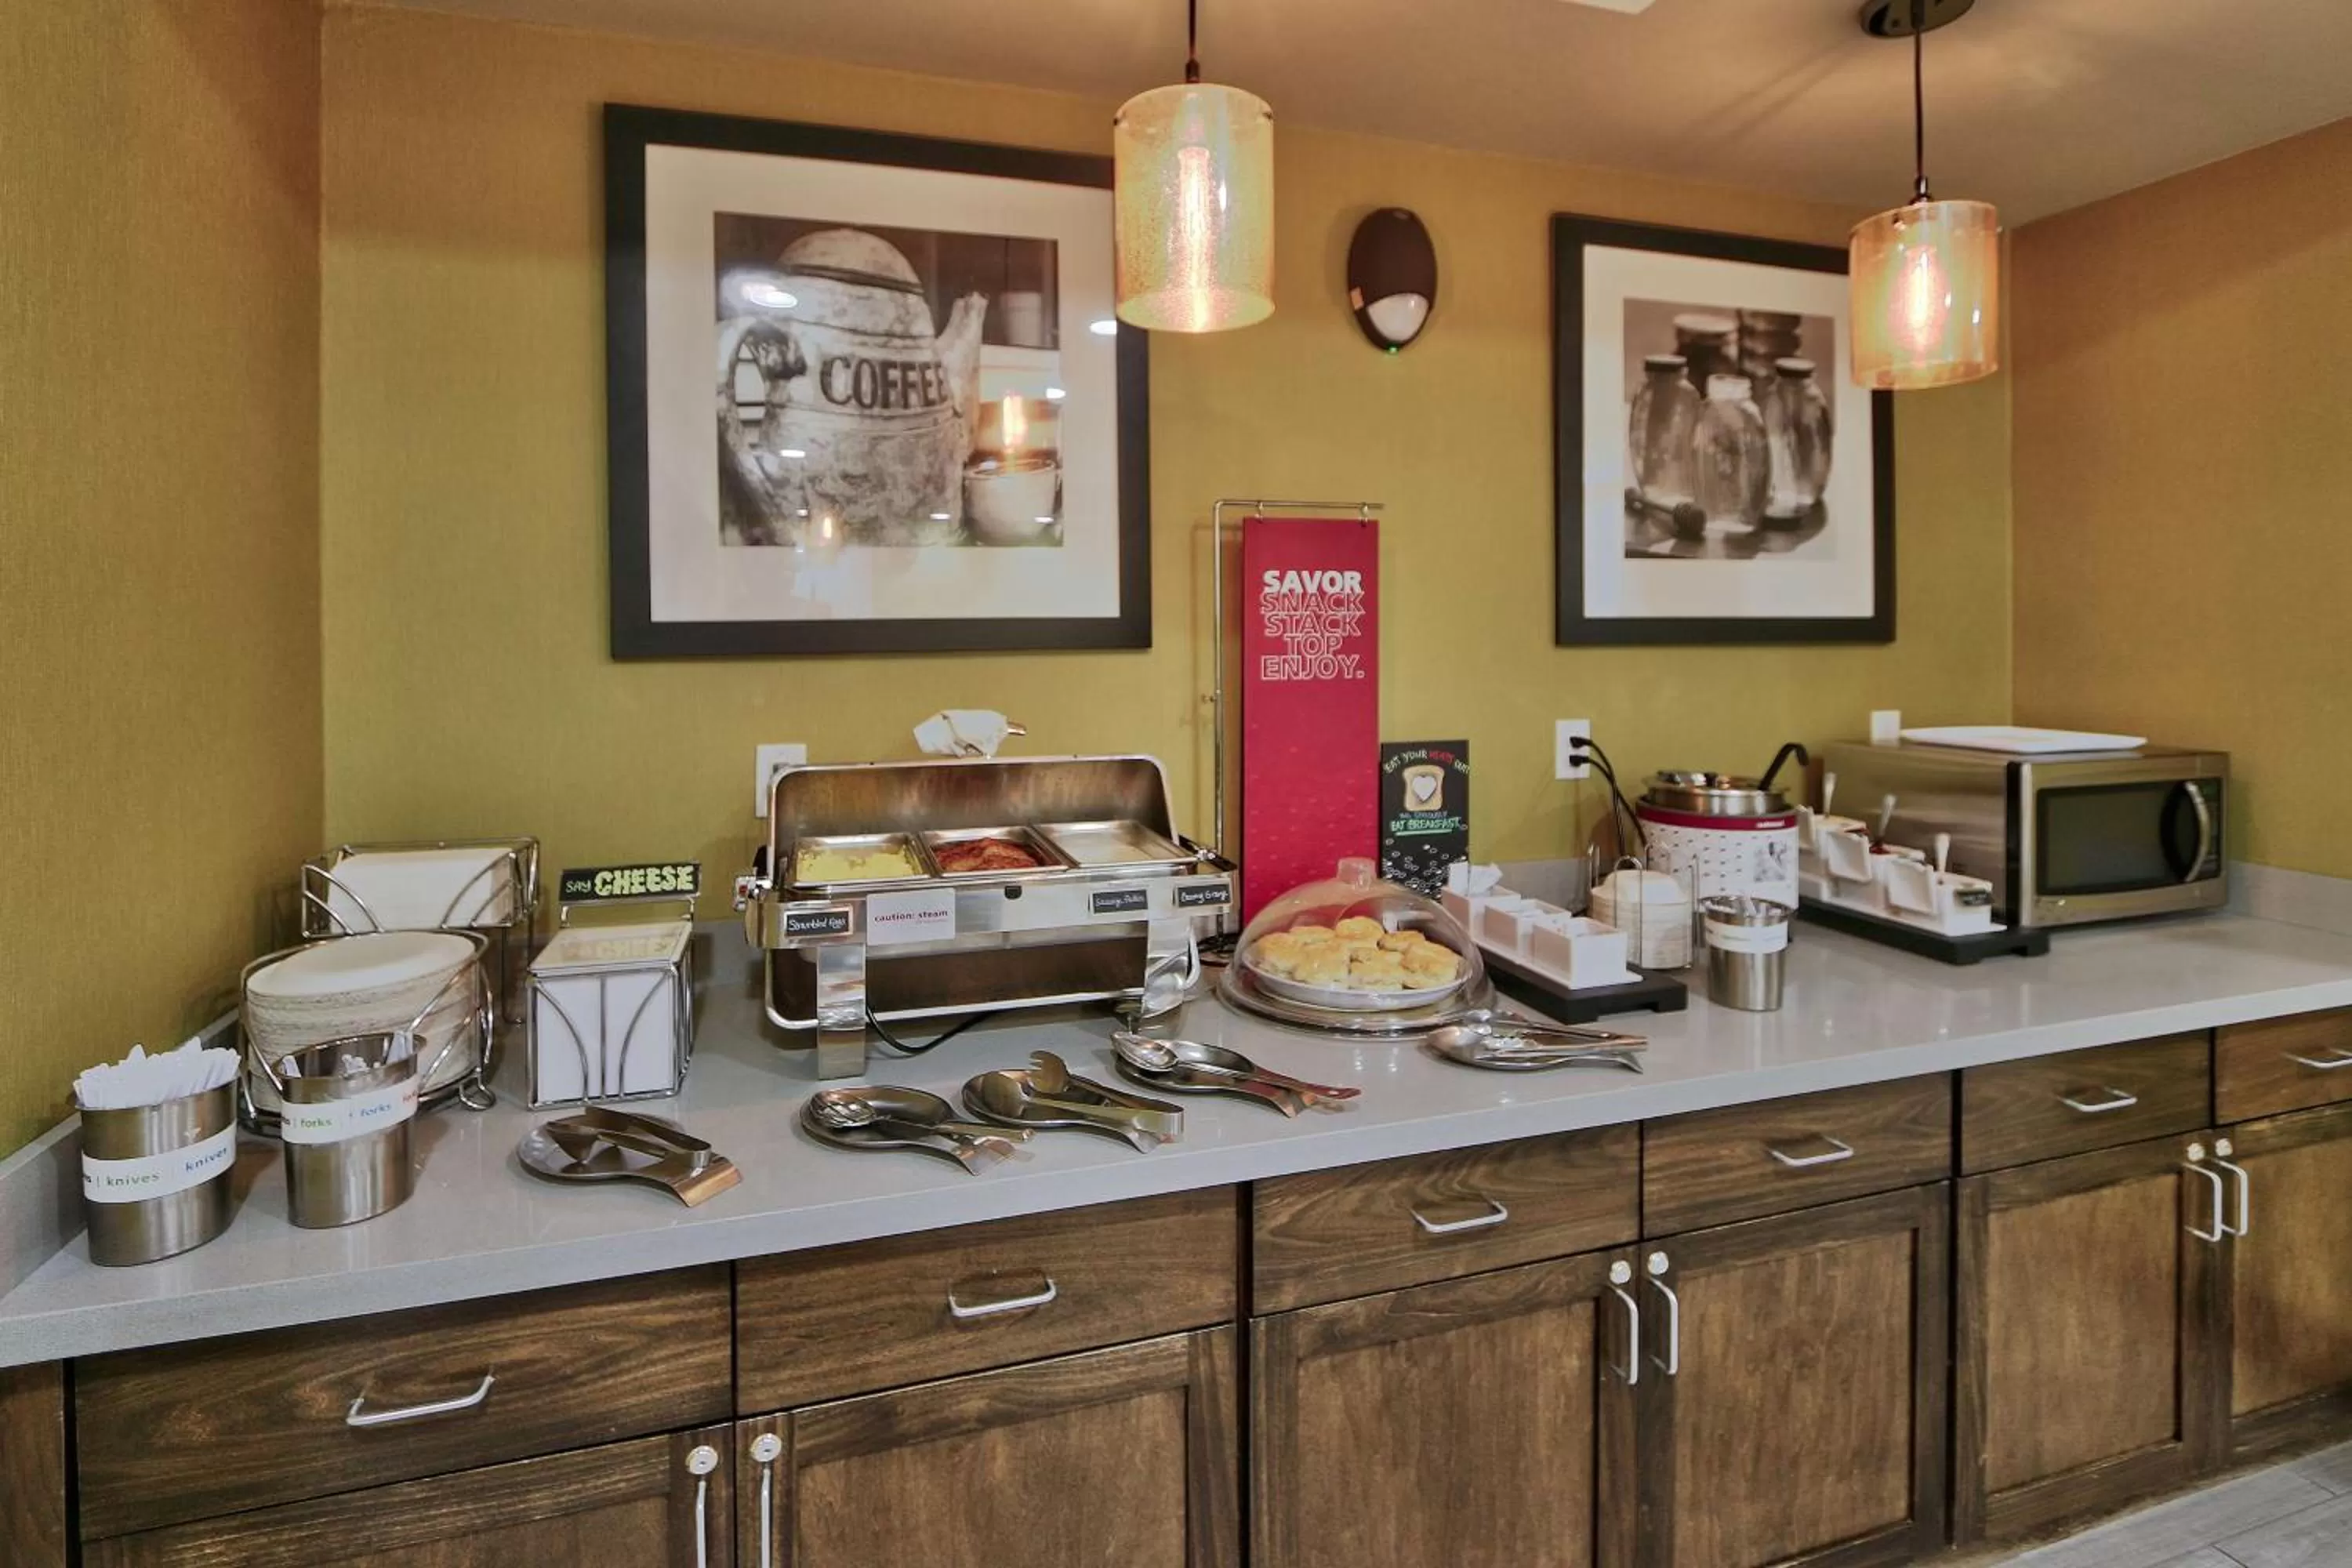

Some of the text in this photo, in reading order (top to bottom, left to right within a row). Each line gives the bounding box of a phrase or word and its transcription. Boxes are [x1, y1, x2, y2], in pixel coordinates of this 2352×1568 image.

[819, 356, 949, 409] COFFEE
[1263, 570, 1363, 593] SAVOR
[1261, 592, 1366, 614] SNACK
[1264, 612, 1362, 636] STACK
[1284, 633, 1342, 658] TOP
[1261, 655, 1365, 680] ENJOY.
[1390, 817, 1461, 832] EAT BREAKFAST
[565, 866, 694, 896] SAY CHEESE
[918, 910, 948, 919] steam
[300, 1118, 332, 1128] forks
[360, 1104, 390, 1116] forks
[106, 1172, 160, 1186] knives
